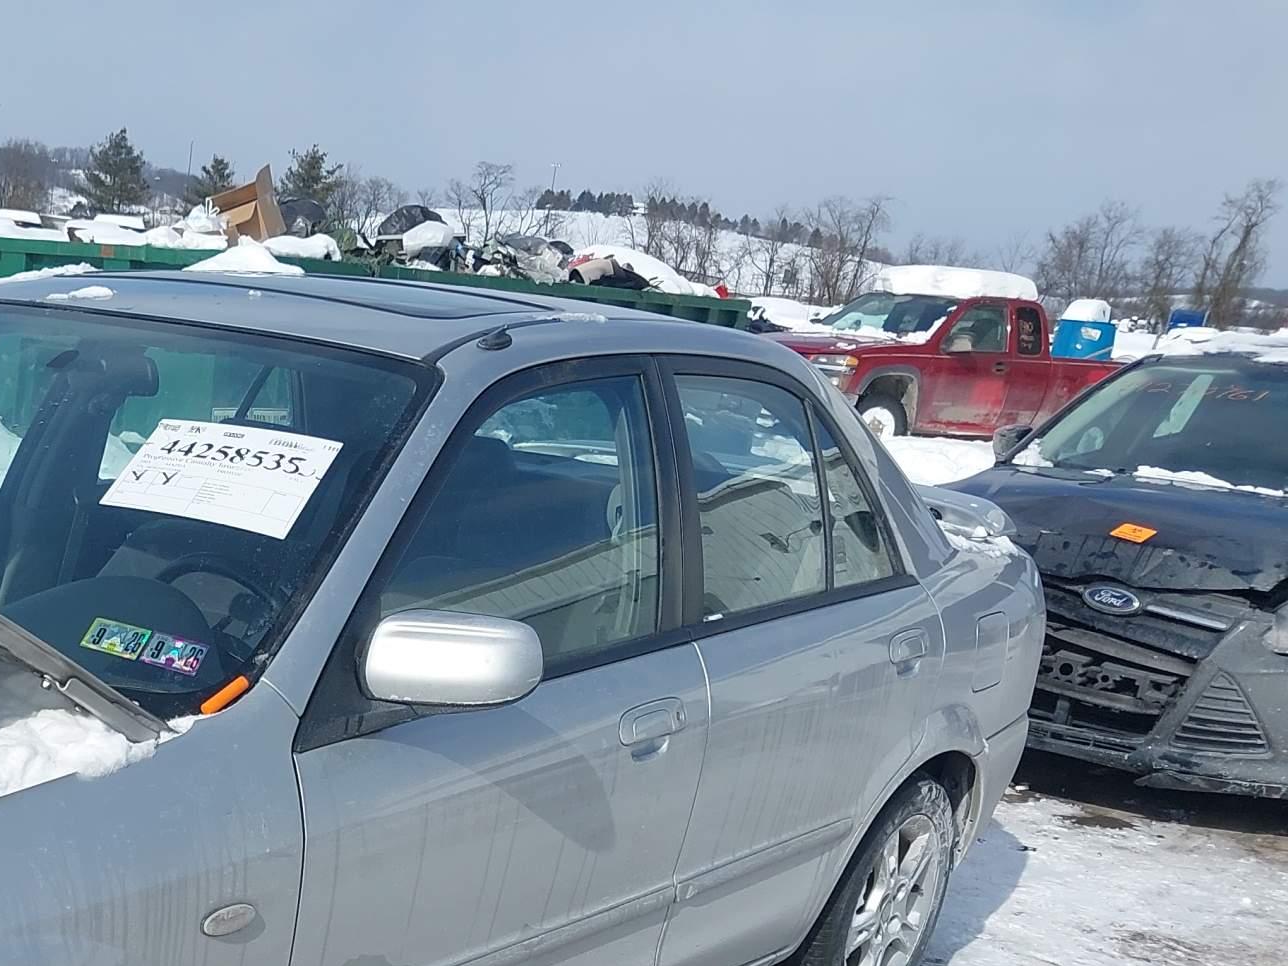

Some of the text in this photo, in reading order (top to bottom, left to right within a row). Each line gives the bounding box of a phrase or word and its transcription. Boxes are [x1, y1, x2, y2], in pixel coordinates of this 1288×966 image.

[160, 439, 307, 474] 44258535
[1094, 589, 1128, 608] Ford
[92, 627, 108, 645] 9
[150, 640, 166, 659] 9
